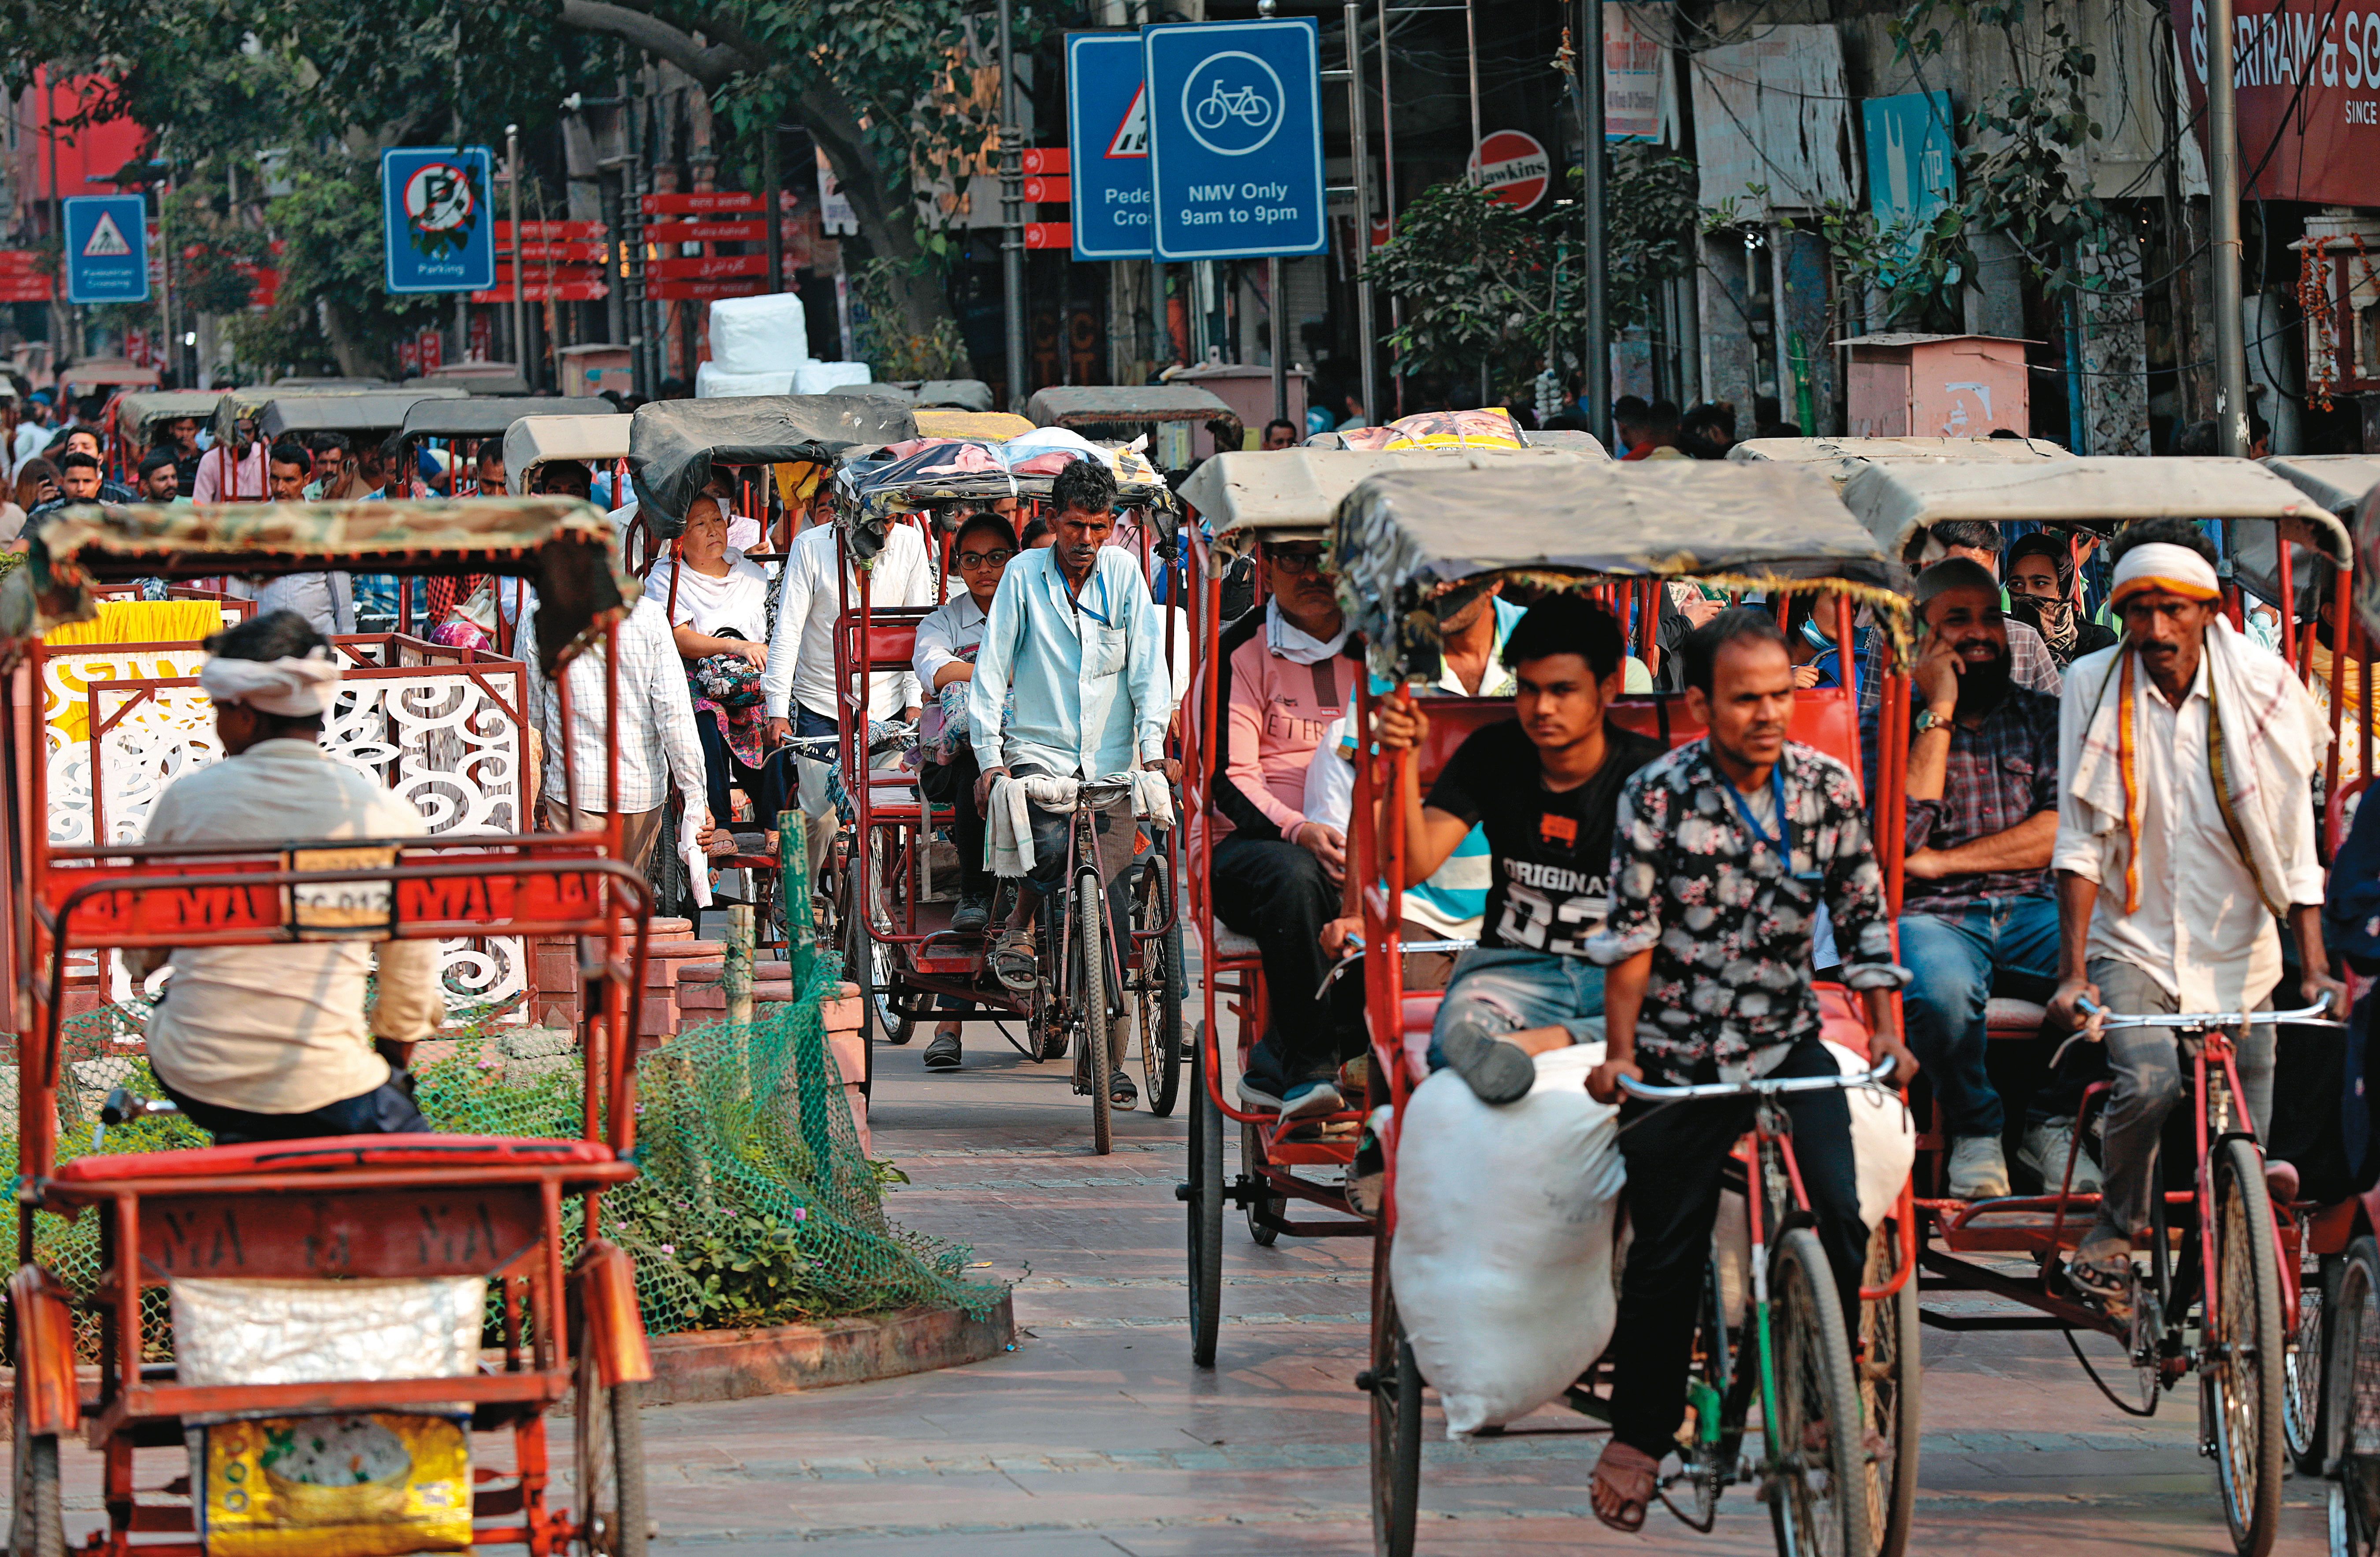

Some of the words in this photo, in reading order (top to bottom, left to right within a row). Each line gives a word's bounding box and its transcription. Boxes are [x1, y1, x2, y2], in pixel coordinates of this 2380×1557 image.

[2321, 12, 2339, 88] &
[2345, 100, 2377, 125] SINCE
[1188, 183, 1236, 202] NMV
[1241, 182, 1288, 202] Only
[1113, 209, 1152, 226] Cro
[1180, 208, 1223, 225] 9am
[1229, 207, 1250, 223] to
[1254, 205, 1298, 225] 9pm
[417, 263, 465, 277] Parking
[1503, 857, 1612, 896] ORIGINA
